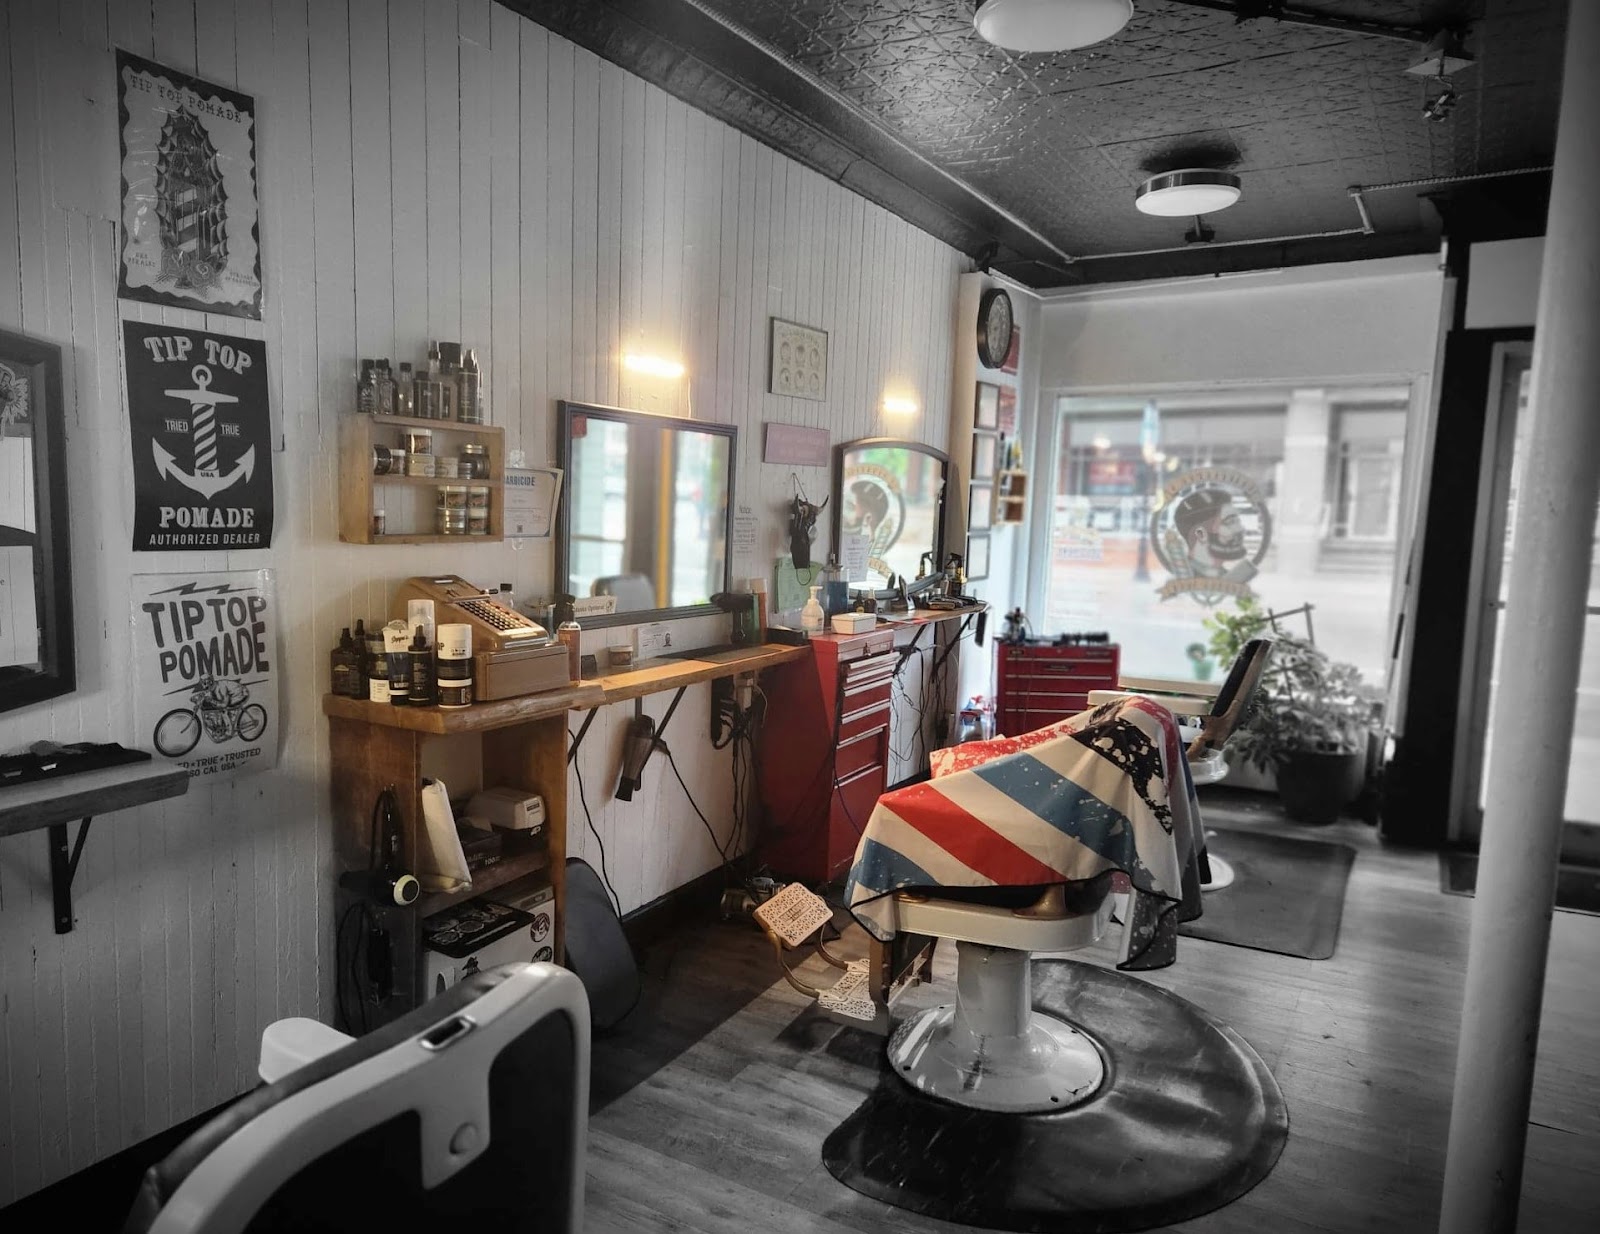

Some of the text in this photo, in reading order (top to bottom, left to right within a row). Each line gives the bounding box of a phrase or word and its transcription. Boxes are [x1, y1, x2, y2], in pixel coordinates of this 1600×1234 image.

[130, 75, 241, 123] TIP TOP POMADE
[143, 336, 252, 375] TIP TOP
[165, 419, 189, 432] TRIED
[221, 424, 240, 436] TRUE
[504, 475, 536, 486] ARBICIDE
[158, 506, 255, 529] POMADE
[150, 532, 260, 545] AUTHORIZED DEALER
[142, 596, 266, 648] TIP TOP
[159, 621, 270, 683] POMADE
[196, 748, 261, 767] TRUE TRUSTED
[189, 762, 236, 777] SO CAL USA
